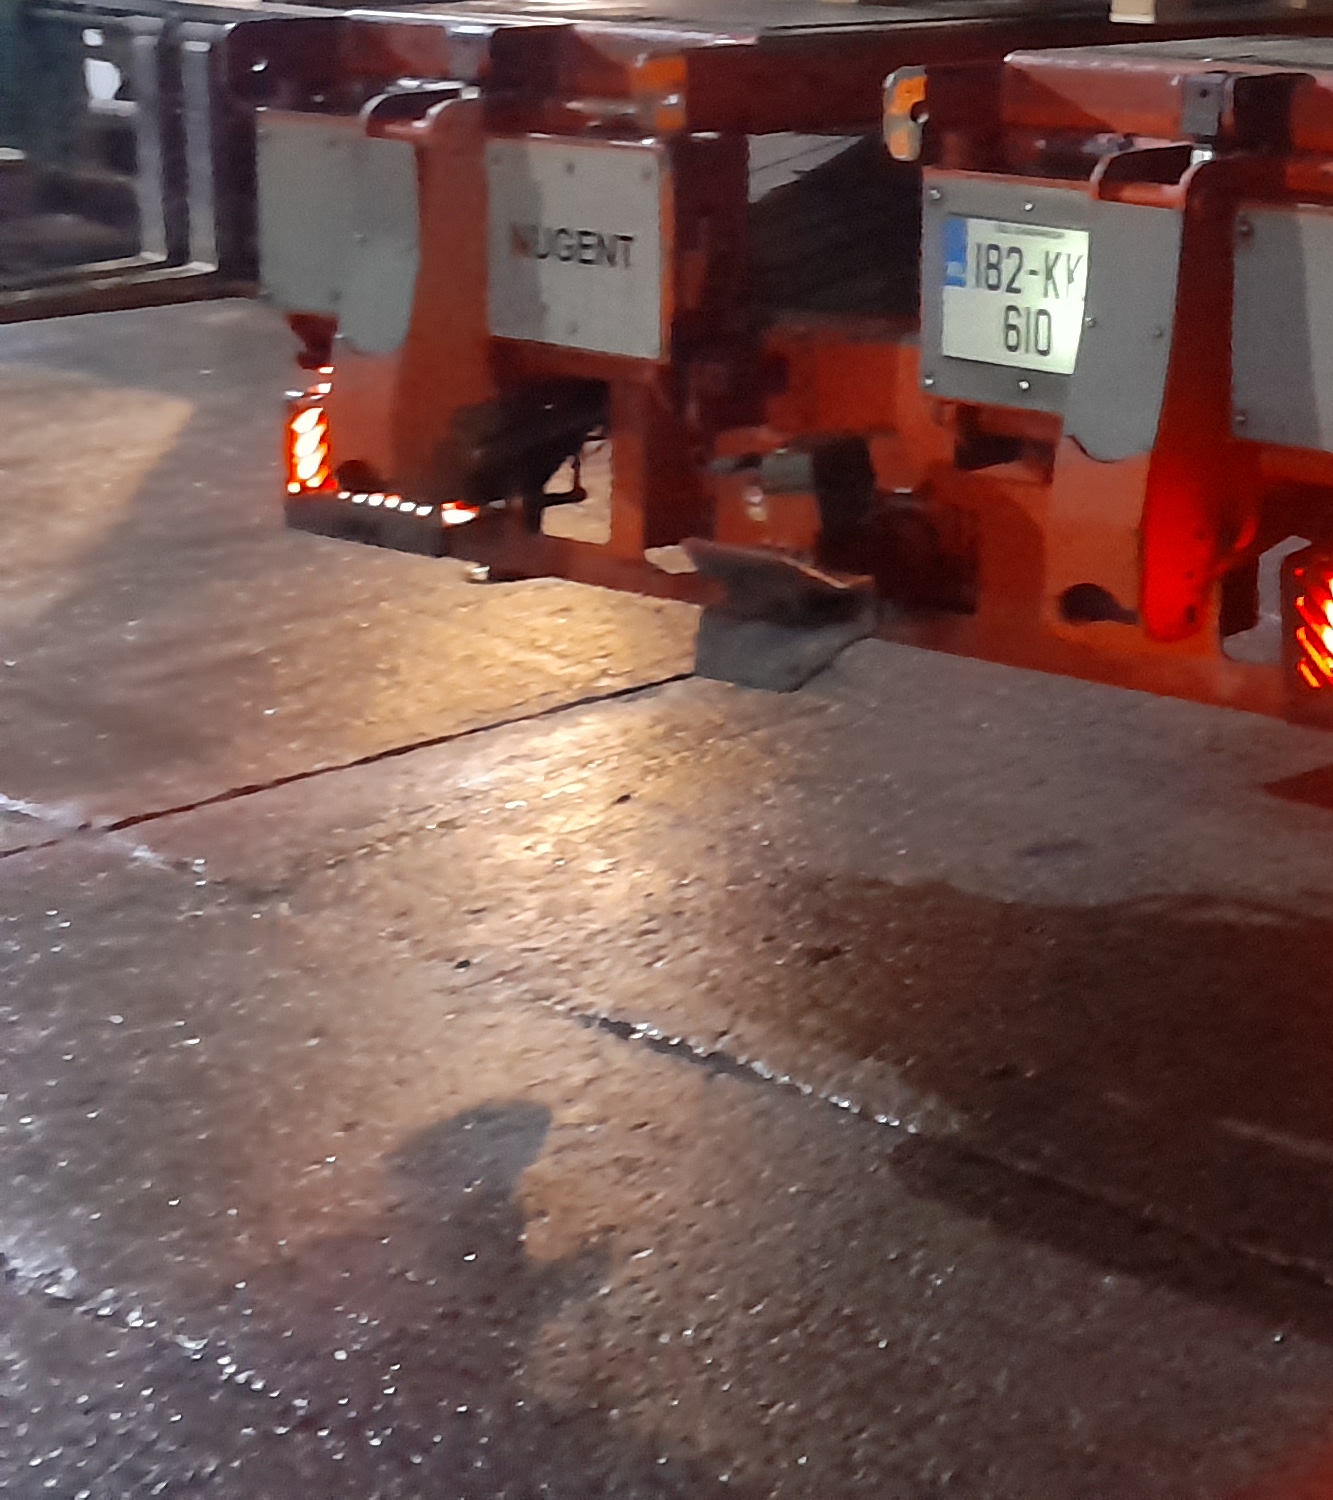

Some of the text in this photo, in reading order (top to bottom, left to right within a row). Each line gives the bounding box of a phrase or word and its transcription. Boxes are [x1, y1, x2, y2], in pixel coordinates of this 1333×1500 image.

[510, 222, 636, 268] NUGENT
[973, 242, 1084, 299] 182-KY
[1003, 304, 1052, 357] 610
